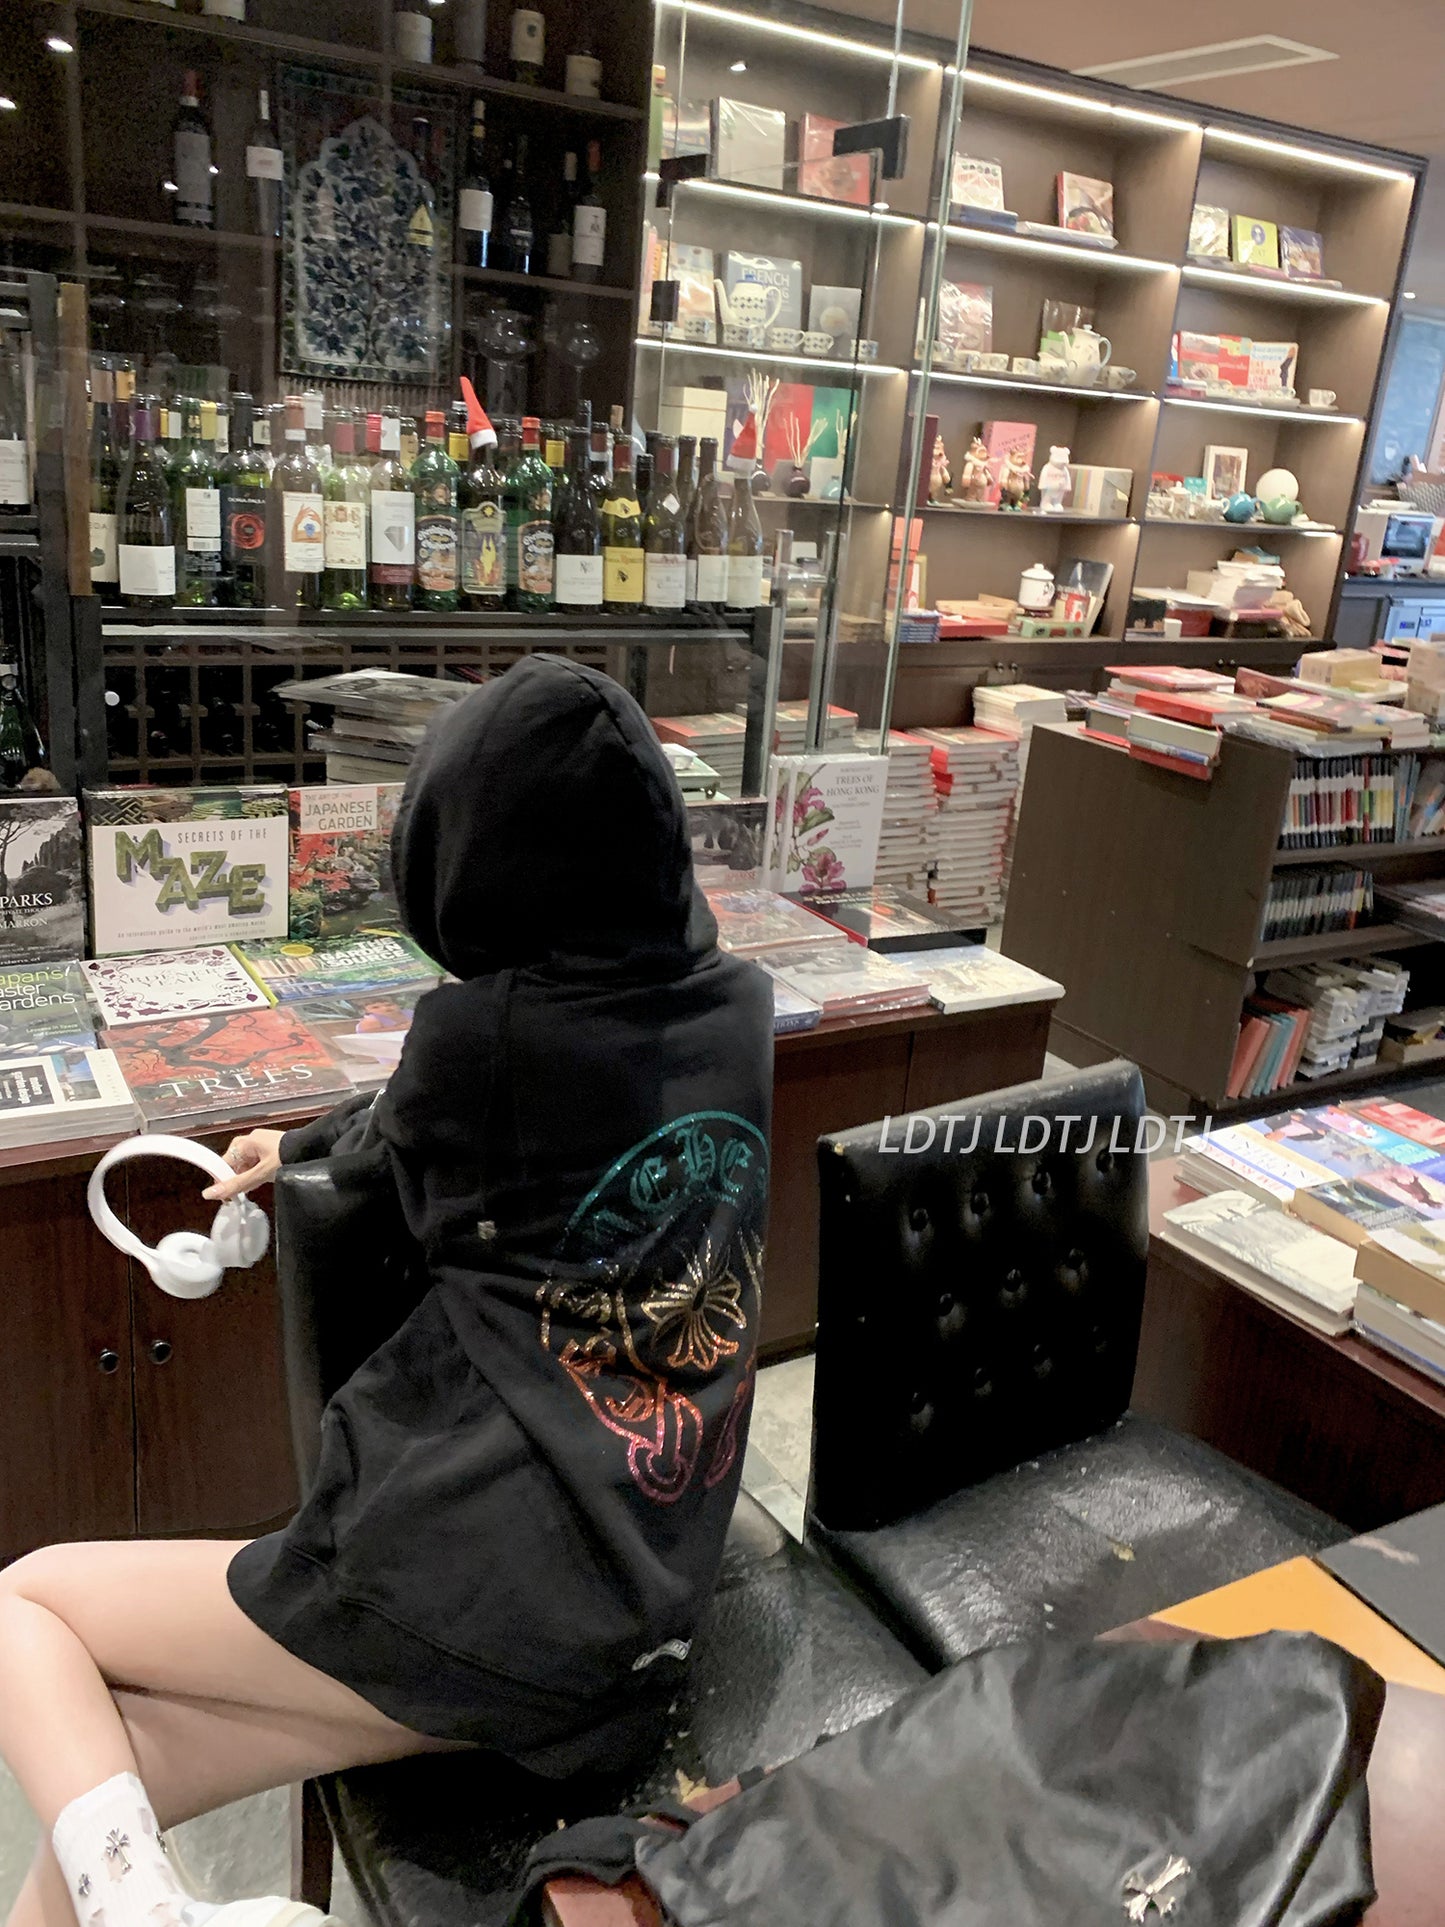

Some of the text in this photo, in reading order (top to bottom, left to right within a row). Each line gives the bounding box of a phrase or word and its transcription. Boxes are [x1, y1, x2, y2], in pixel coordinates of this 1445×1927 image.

[826, 785, 880, 797] HONG KONG
[305, 801, 373, 816] JAPANESE
[318, 815, 373, 831] GARDEN
[177, 828, 267, 844] SECRETS OF THE
[115, 828, 266, 916] MAZE
[0, 892, 53, 908] PARKS
[353, 937, 393, 949] THE
[320, 944, 403, 960] GARDEN
[326, 951, 410, 967] SOURCE
[159, 1063, 313, 1098] TREES
